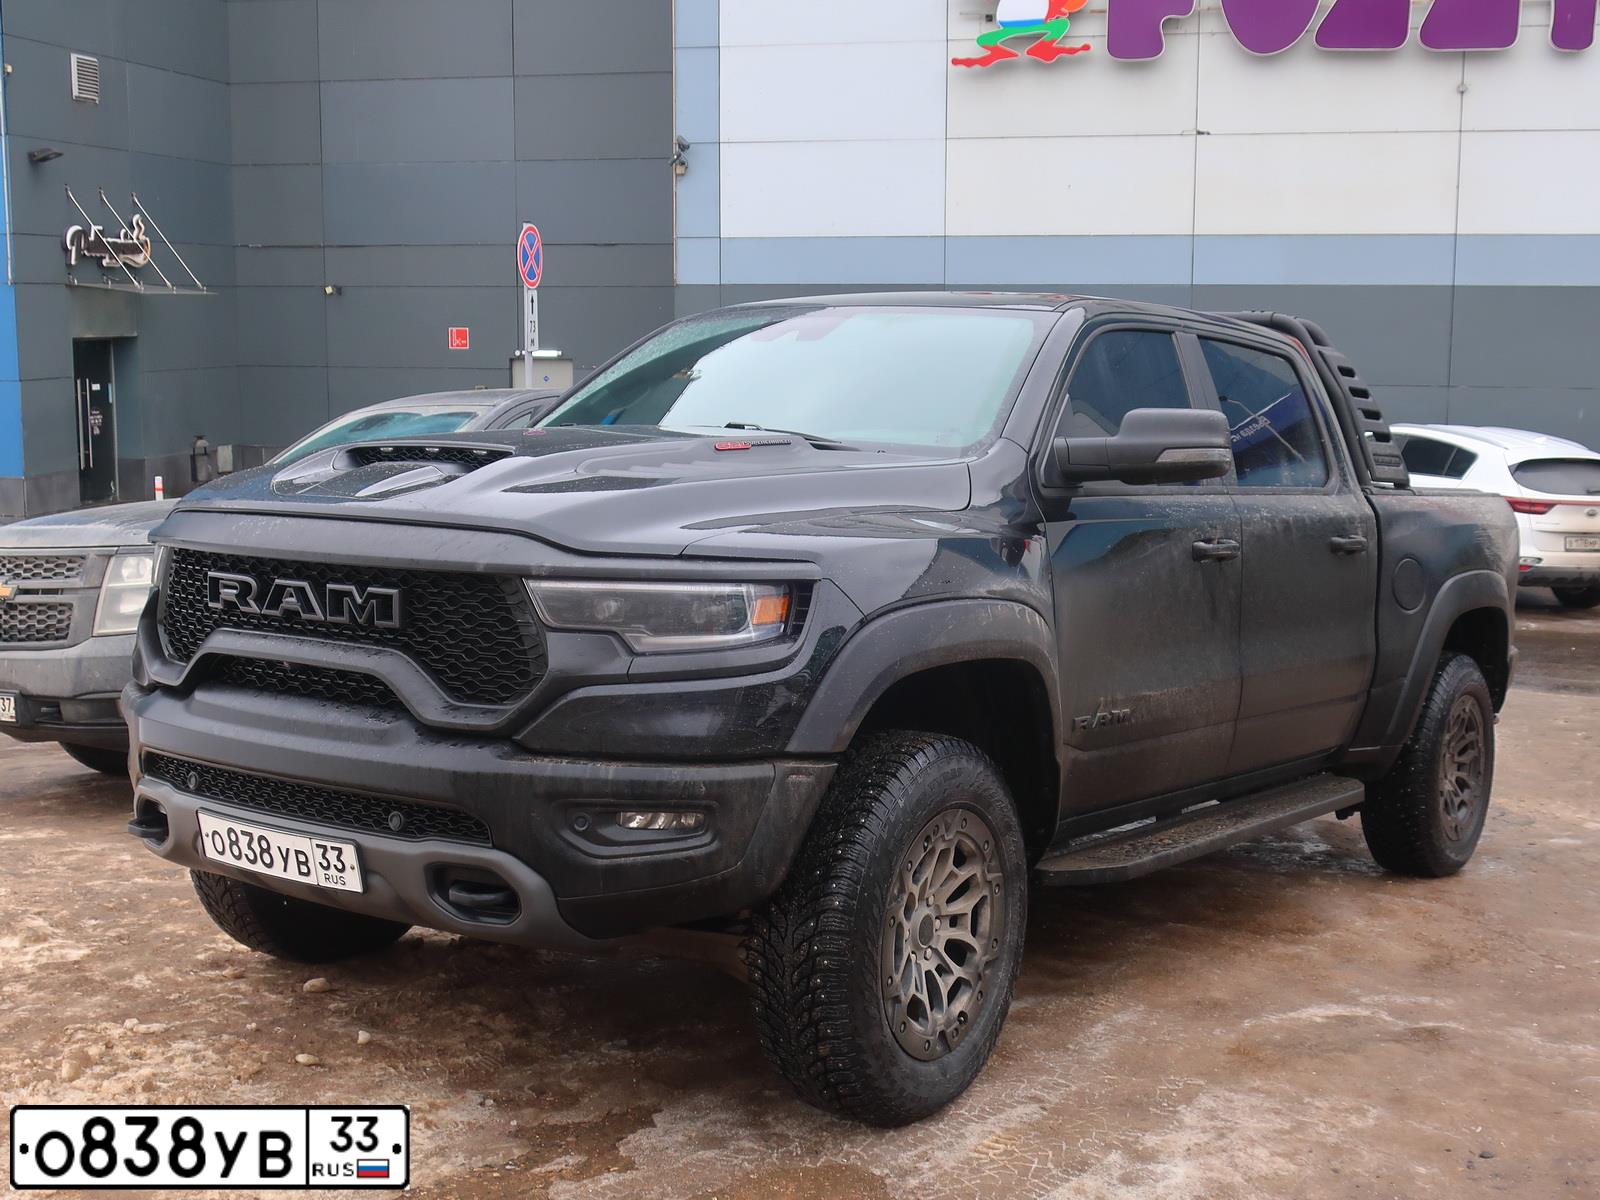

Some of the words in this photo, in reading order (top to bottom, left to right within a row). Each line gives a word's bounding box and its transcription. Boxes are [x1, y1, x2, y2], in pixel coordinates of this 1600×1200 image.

[530, 320, 536, 333] 73
[208, 571, 400, 628] RAM
[0, 697, 11, 712] 37
[315, 843, 346, 874] 33
[324, 873, 346, 886] RUS
